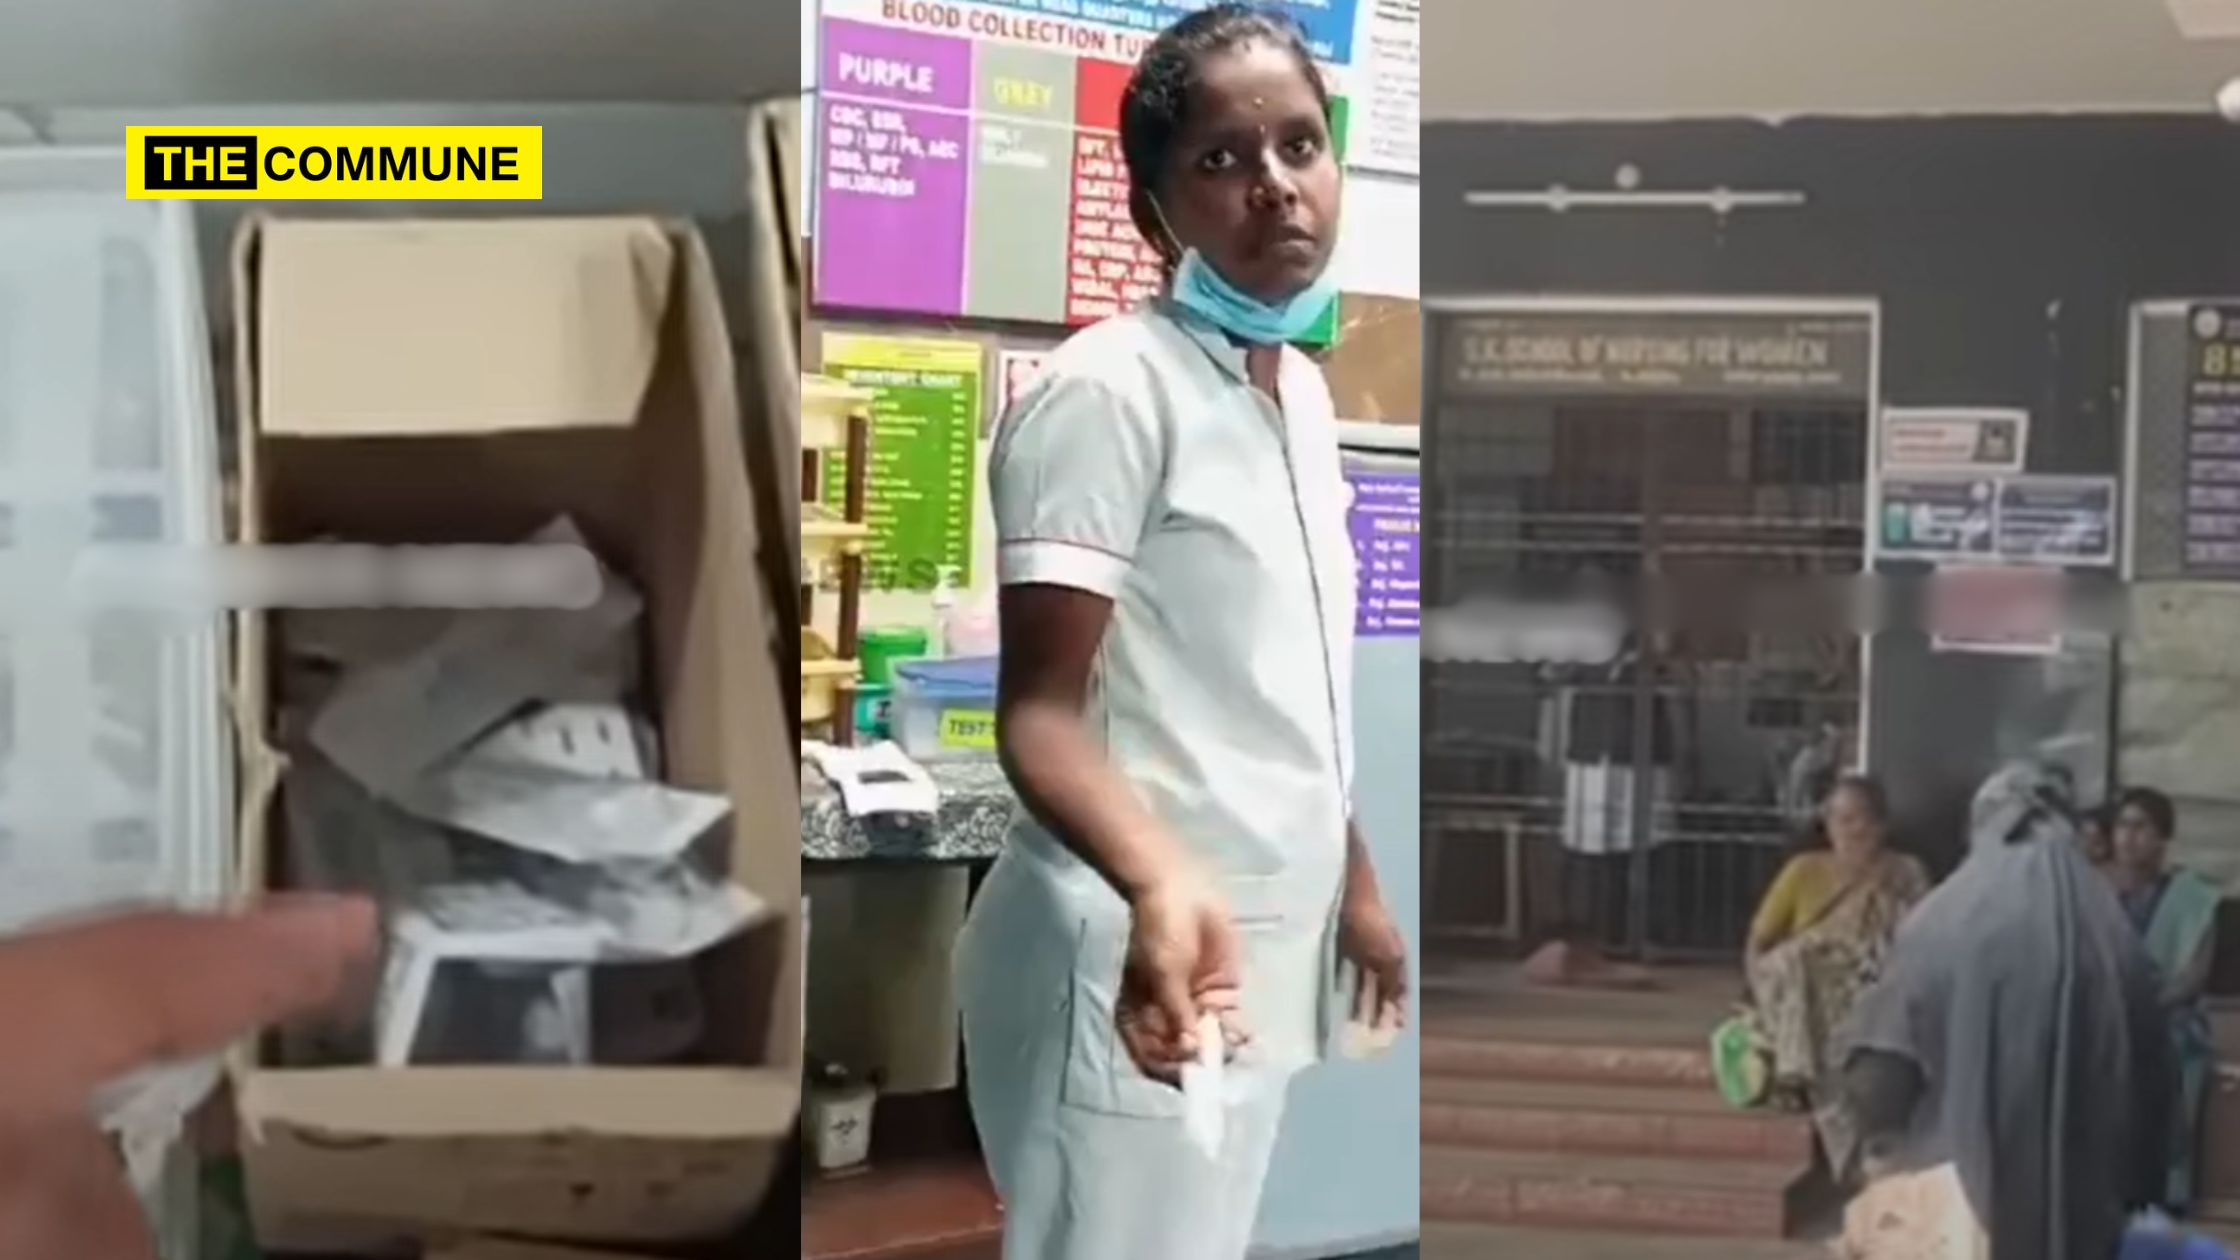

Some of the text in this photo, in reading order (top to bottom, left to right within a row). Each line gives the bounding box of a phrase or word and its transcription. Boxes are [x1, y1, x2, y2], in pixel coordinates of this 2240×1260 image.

[882, 0, 960, 28] BLOOD
[968, 10, 1106, 50] COLLECTION
[838, 53, 934, 93] PURPLE
